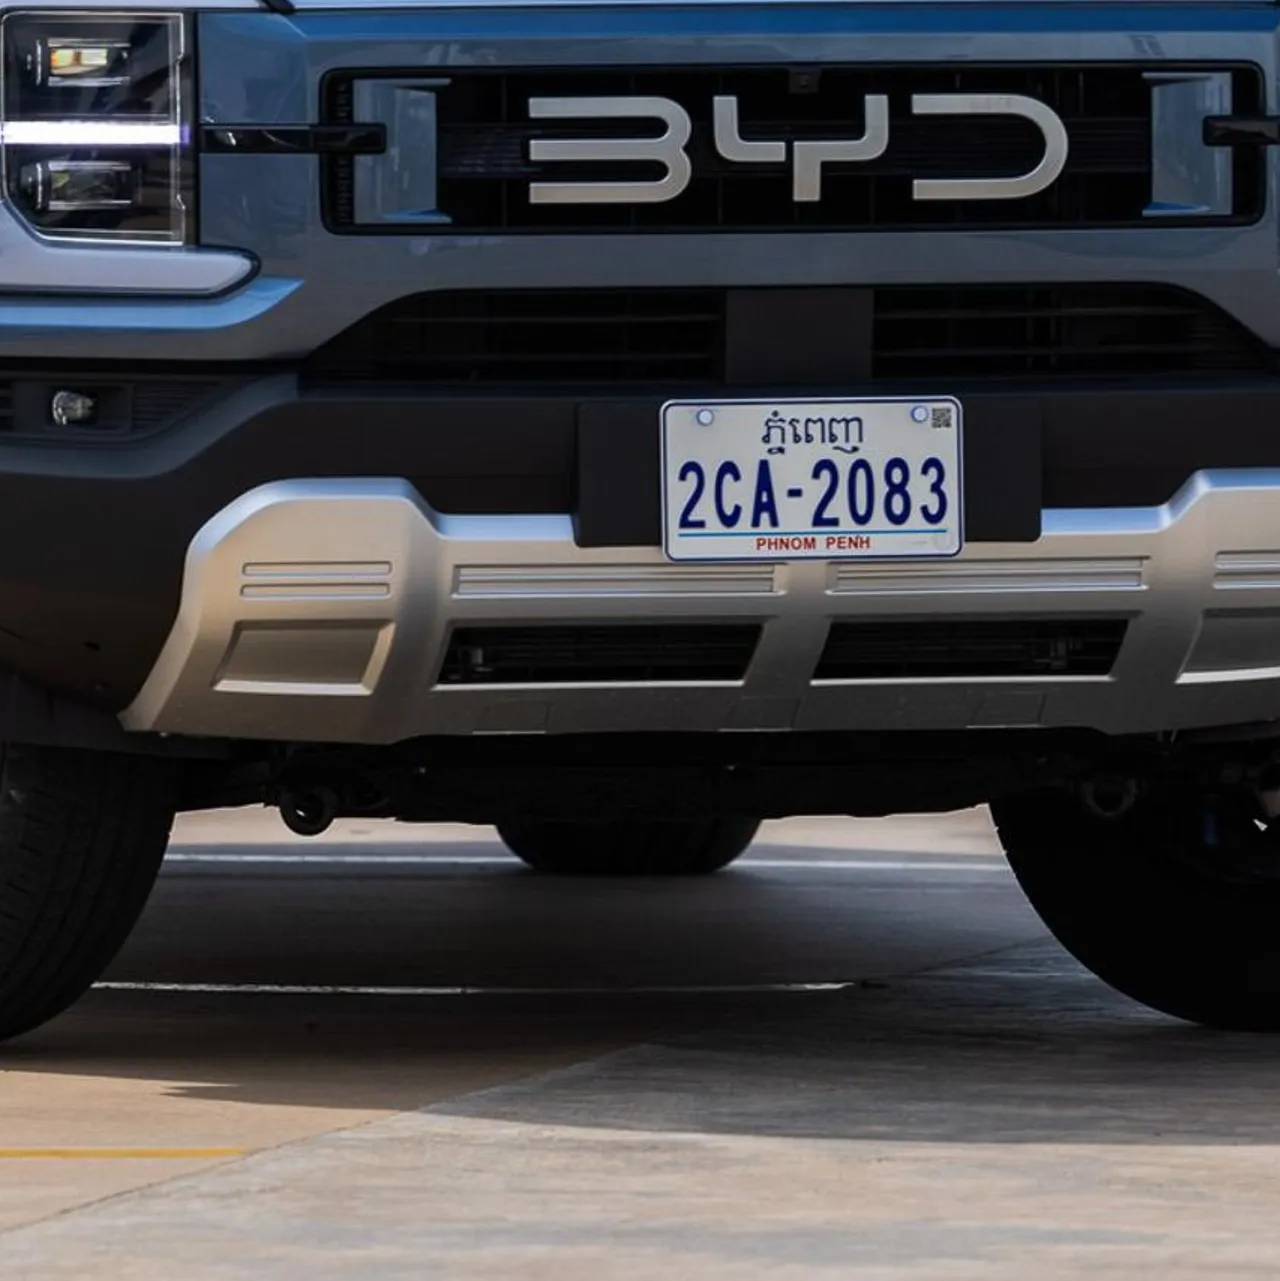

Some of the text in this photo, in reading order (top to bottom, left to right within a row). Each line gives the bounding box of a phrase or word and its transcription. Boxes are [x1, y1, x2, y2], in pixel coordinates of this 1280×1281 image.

[528, 94, 1069, 204] BYD
[761, 410, 864, 455] ភ្នំពេញ
[678, 456, 948, 529] 2CA-2083
[756, 536, 871, 551] PHNOM PENH
